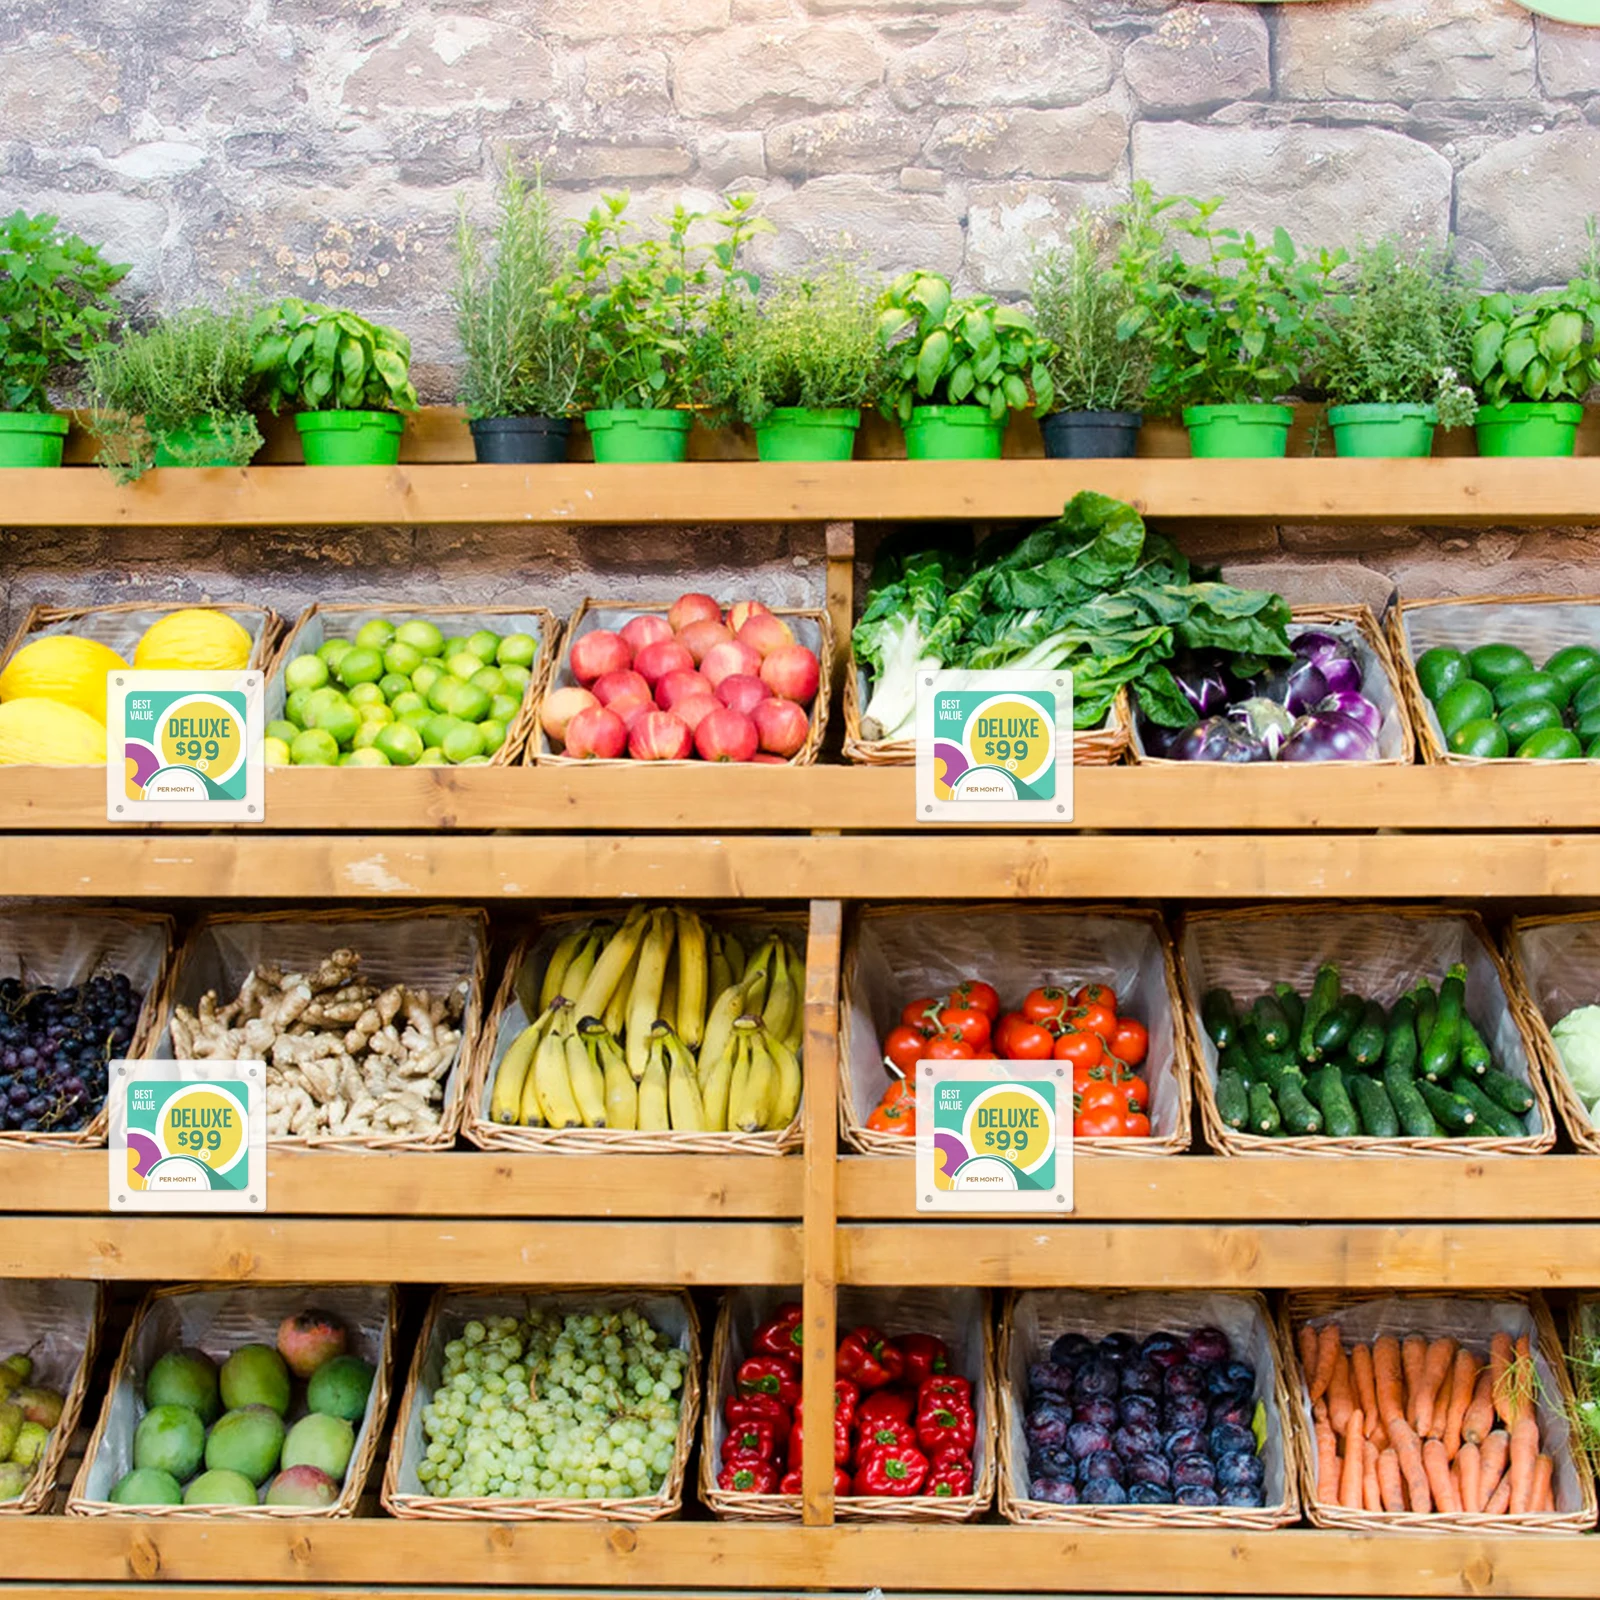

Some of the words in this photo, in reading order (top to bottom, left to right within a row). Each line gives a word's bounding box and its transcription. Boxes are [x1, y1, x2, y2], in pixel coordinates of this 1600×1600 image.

[132, 700, 150, 709] BEST
[941, 700, 960, 709] BEST
[130, 710, 153, 720] VALUE
[939, 710, 962, 720] VALUE
[169, 718, 230, 738] DELUXE
[978, 718, 1039, 738] DELUXE
[176, 740, 219, 760] $99
[985, 740, 1028, 760] $99
[134, 1090, 152, 1099] BEST
[941, 1090, 960, 1099] BEST
[132, 1100, 155, 1110] VALUE
[939, 1100, 962, 1110] VALUE
[171, 1108, 232, 1128] DELUXE
[978, 1108, 1039, 1128] DELUXE
[178, 1130, 221, 1150] $99
[985, 1130, 1028, 1150] $99
